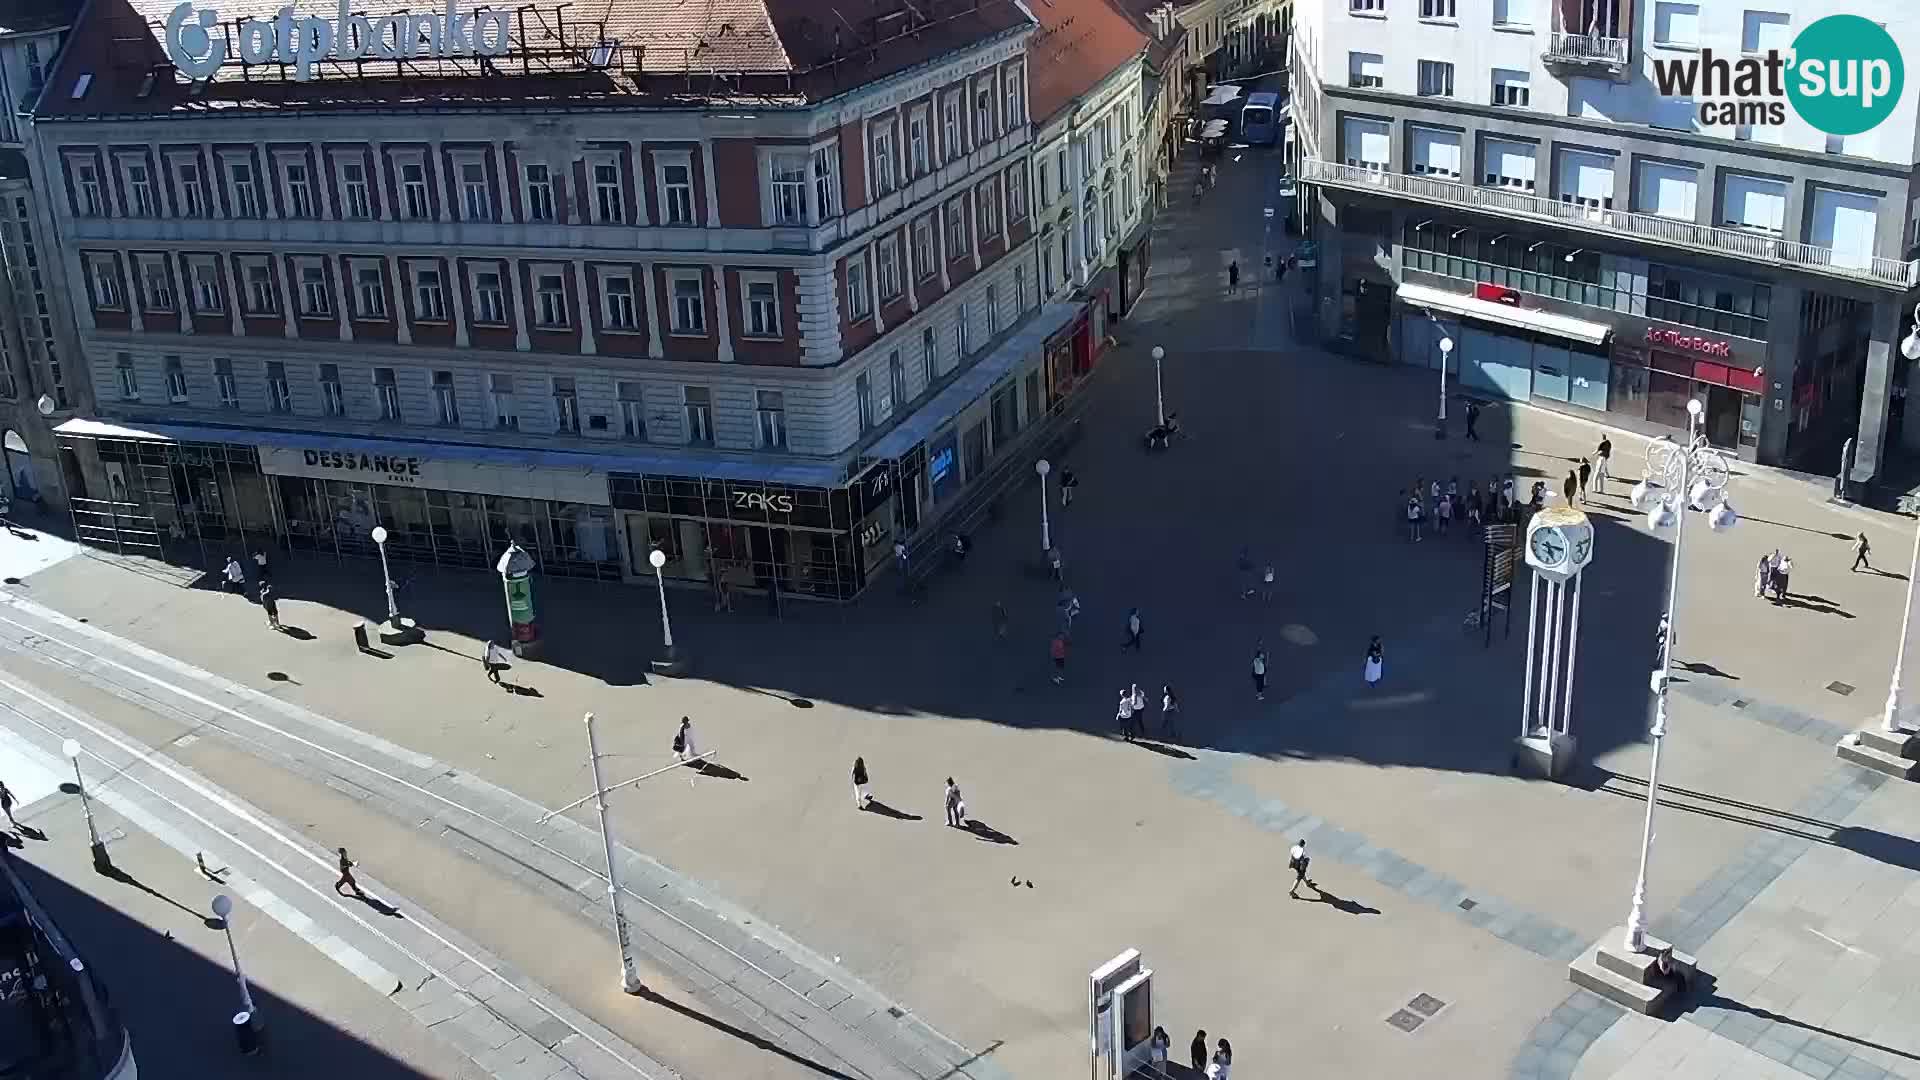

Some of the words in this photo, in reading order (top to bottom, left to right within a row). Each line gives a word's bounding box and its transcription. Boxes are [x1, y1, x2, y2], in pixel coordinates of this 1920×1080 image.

[240, 6, 333, 82] otp
[336, 0, 511, 60] banka
[1693, 337, 1730, 357] Bank
[303, 449, 420, 476] DESSANGE
[733, 491, 793, 513] ZAKS
